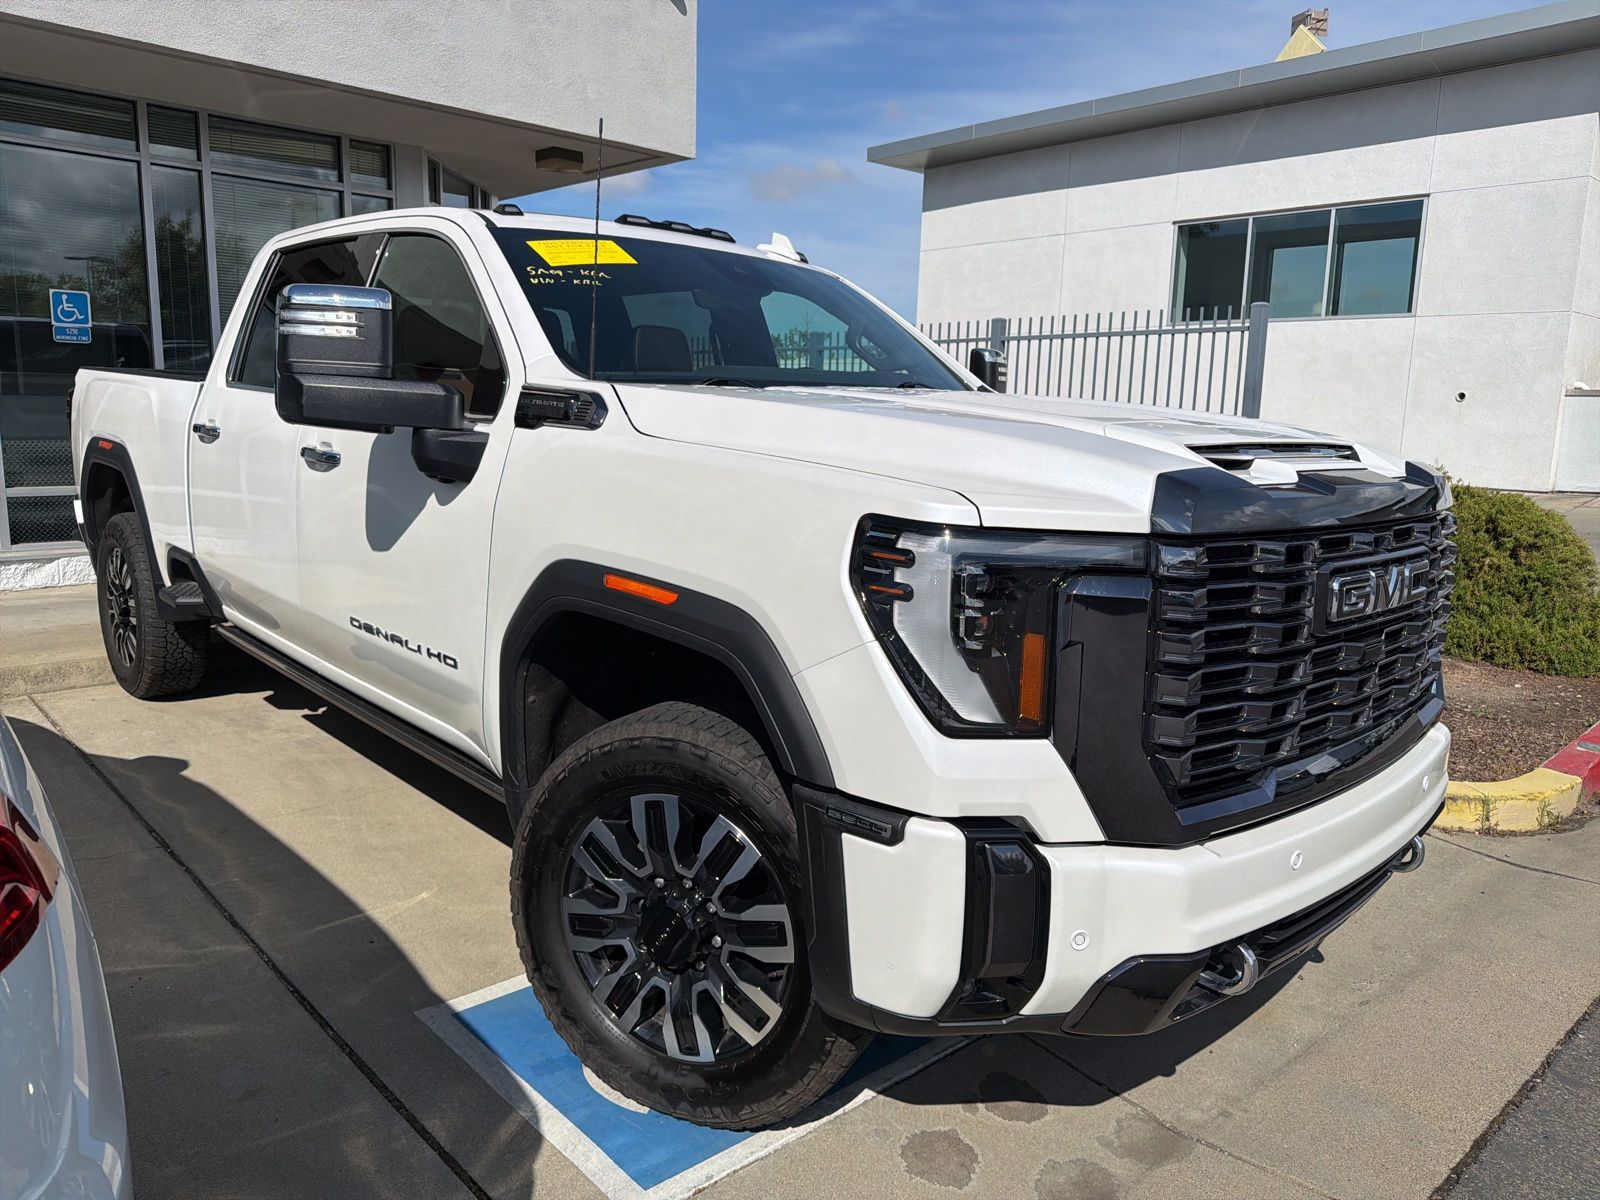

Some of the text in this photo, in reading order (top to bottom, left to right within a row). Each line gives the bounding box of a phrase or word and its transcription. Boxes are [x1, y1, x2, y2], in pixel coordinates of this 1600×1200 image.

[1326, 559, 1430, 622] GMC
[349, 615, 459, 670] DENALI HD
